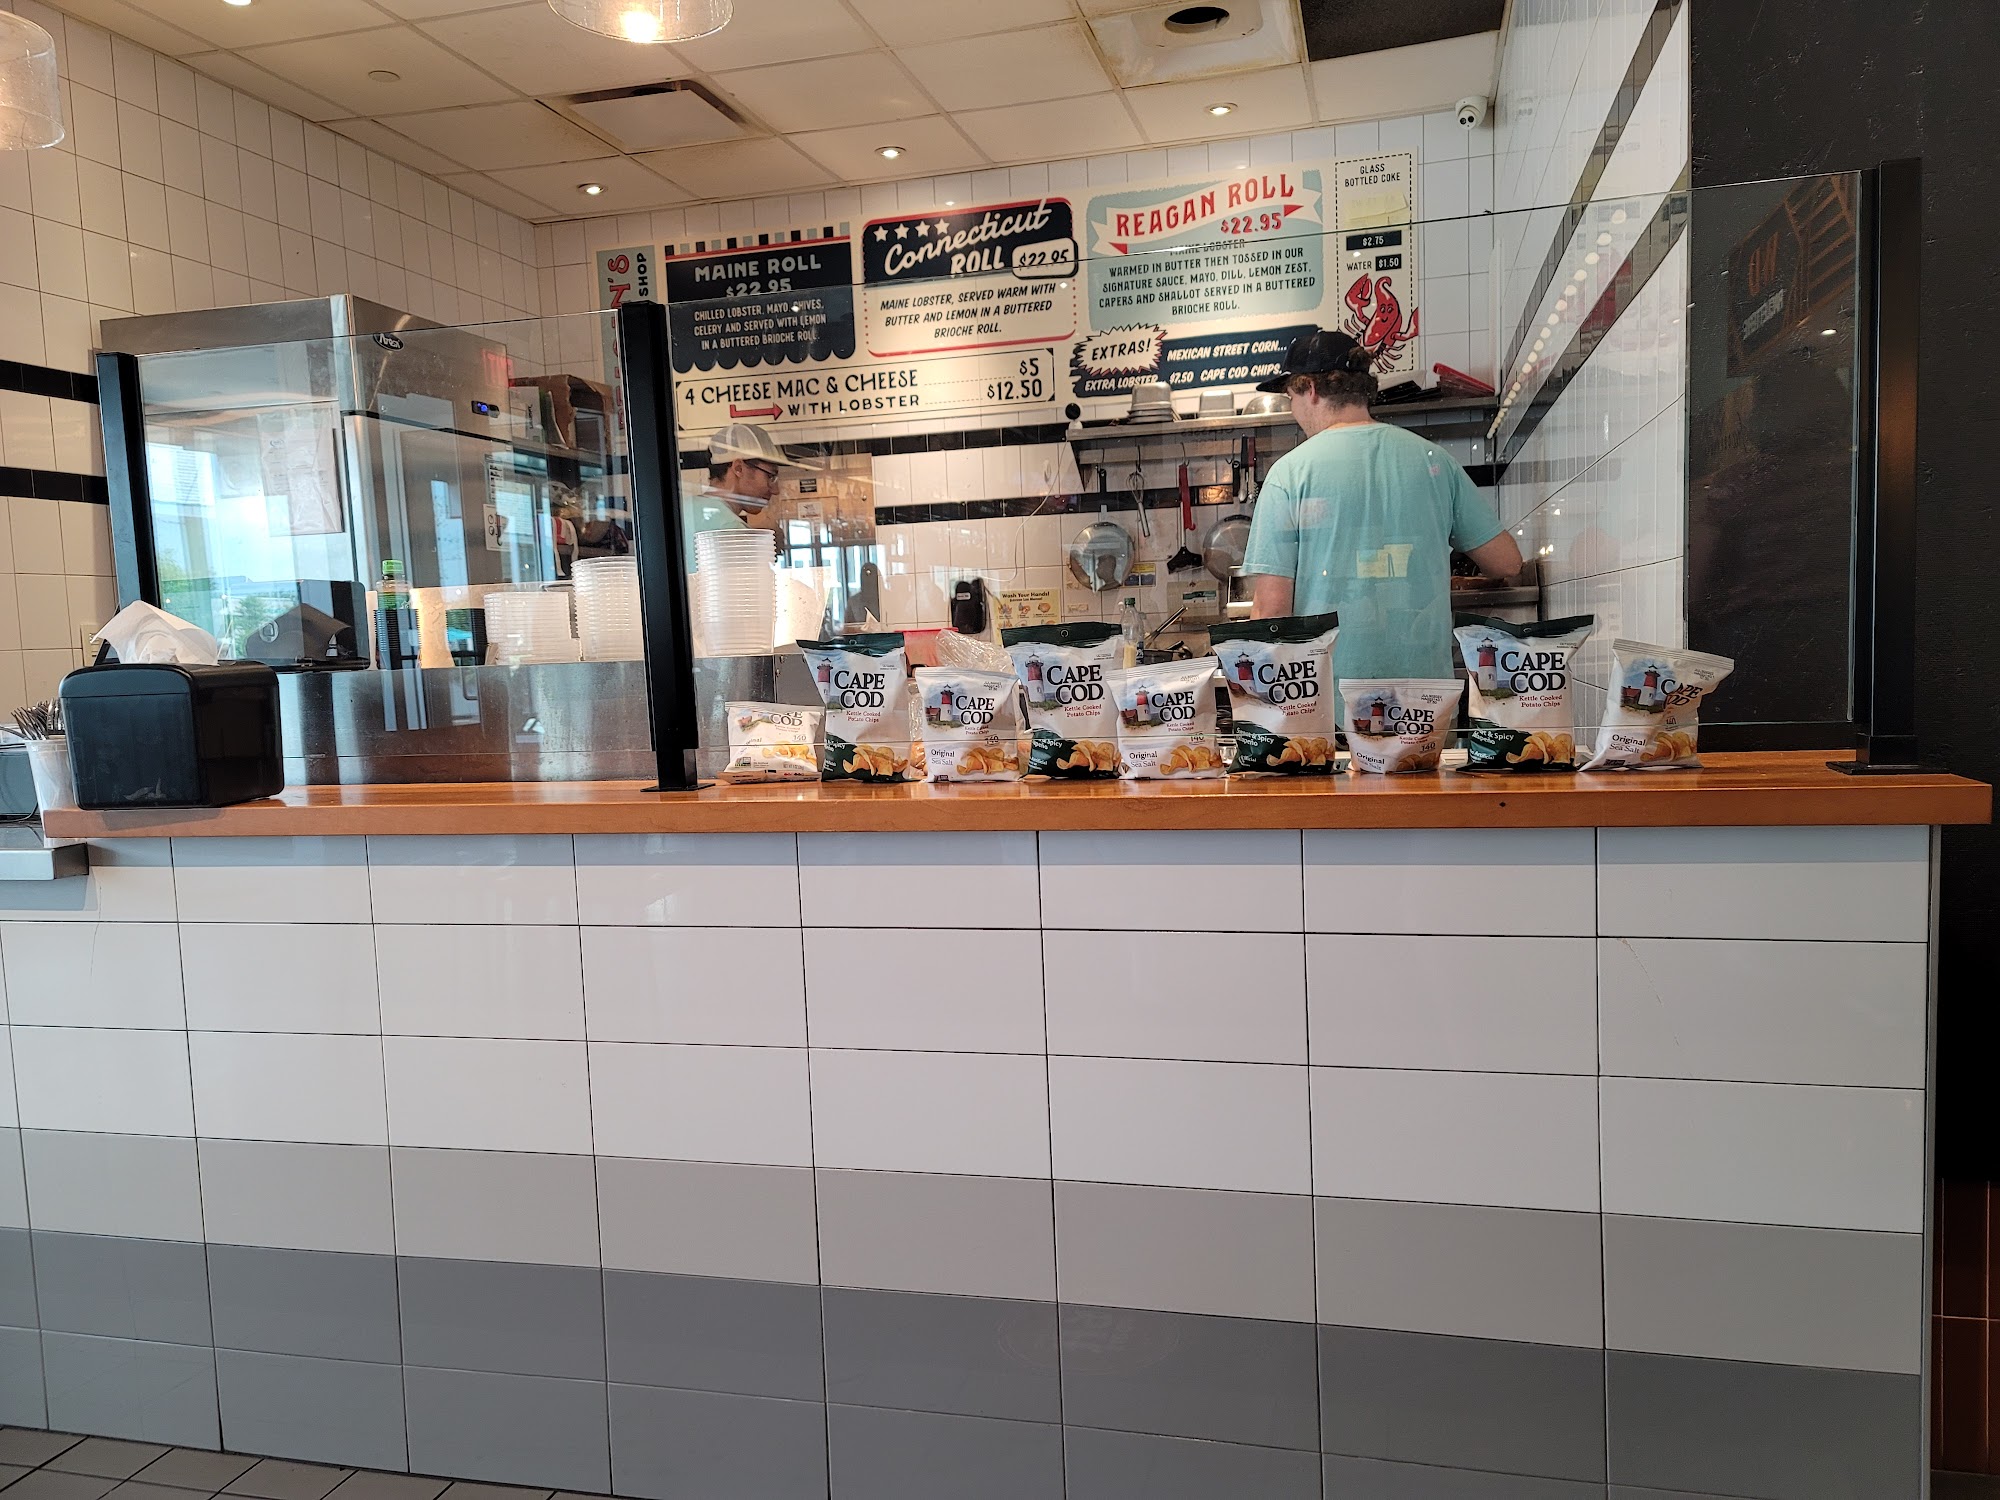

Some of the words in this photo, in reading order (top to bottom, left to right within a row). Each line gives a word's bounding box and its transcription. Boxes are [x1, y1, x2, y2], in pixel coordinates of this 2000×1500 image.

[1360, 163, 1385, 175] GLASS
[1345, 173, 1378, 187] BOTTLED
[1381, 172, 1401, 183] COKE
[1116, 191, 1215, 237] REAGAN
[1228, 174, 1294, 208] ROLL
[1220, 212, 1282, 235] $22.95
[884, 199, 1053, 276] Connecticut
[1362, 235, 1384, 247] $2.75
[695, 261, 759, 282] MAINE
[767, 254, 822, 275] ROLL
[951, 246, 1005, 275] ROLL
[1019, 249, 1069, 268] $2295
[1109, 264, 1149, 278] WARMED
[1152, 262, 1162, 273] IN
[1165, 259, 1201, 272] BUTTER
[1204, 256, 1229, 268] THEN
[1232, 253, 1268, 265] TOSSED
[1272, 250, 1281, 261] IN
[1285, 247, 1304, 258] OUR
[1346, 260, 1372, 271] WATER
[1378, 256, 1399, 268] $1.50
[637, 252, 649, 297] SHOP
[1103, 278, 1152, 293] SIGNATURE
[1249, 266, 1281, 278] LEMON
[726, 278, 792, 298] $2295
[880, 298, 909, 311] MAINE
[912, 293, 954, 307] LOBSTER,
[958, 289, 994, 303] SERVED
[997, 286, 1028, 299] WARM
[1031, 283, 1056, 295] WITH
[1099, 295, 1133, 308] CAPERS
[1136, 293, 1155, 304] AND
[1158, 289, 1200, 302] SHALLOT
[1204, 285, 1240, 298] SERVED
[1243, 283, 1253, 294] IN
[1256, 282, 1262, 292] A
[1265, 276, 1315, 291] BUTTERED
[694, 310, 725, 321] CHILLED
[885, 313, 920, 327] BUTTER
[923, 311, 943, 323] AND
[946, 308, 977, 320] LEMON
[980, 306, 990, 317] IN
[993, 305, 1000, 316] A
[1004, 300, 1052, 315] BUTTERED
[1172, 302, 1210, 316] BRIOCHE
[1214, 299, 1240, 311] ROLL.
[694, 324, 723, 336] CELERY
[725, 322, 741, 333] AND
[744, 319, 774, 331] SERVED
[777, 316, 798, 328] WITH
[800, 314, 827, 326] LEMON
[934, 325, 974, 338] BRIOCHE
[977, 323, 1002, 335] ROLL.
[701, 340, 710, 350] IN
[712, 339, 718, 349] A
[720, 336, 760, 349] BUTTERED
[762, 332, 795, 345] BRIOCHE
[798, 330, 820, 342] ROLL.
[1092, 338, 1151, 361] EXTRAS!
[1167, 346, 1211, 362] MEXICAN
[1213, 343, 1250, 357] STREET
[1251, 340, 1287, 354] CORN...
[685, 387, 695, 406] 4
[701, 381, 771, 404] CHEESE
[778, 378, 821, 399] MAC
[826, 377, 838, 394] &
[845, 369, 918, 392] CHEESE
[1019, 358, 1039, 377] $5
[1085, 377, 1116, 391] EXTRA
[1169, 371, 1194, 384] $7.50
[1200, 368, 1226, 381] CAPE
[1228, 366, 1249, 379] COD
[788, 401, 831, 417] WITH
[839, 394, 920, 413] LOBSTER
[987, 378, 1043, 402] $12.50
[1500, 651, 1566, 672] CAPE
[834, 670, 885, 689] CAPE
[1046, 665, 1102, 685] CAPE
[1257, 660, 1317, 684] CAPE
[1660, 679, 1703, 699] CAPE
[955, 695, 994, 710] CAPE
[1151, 691, 1194, 708] CAPE
[1388, 706, 1435, 723] CAPE
[1257, 735, 1275, 744] Spicy
[1494, 733, 1514, 741] Spicy
[1609, 743, 1623, 751] Sea
[1612, 734, 1646, 746] Original
[931, 749, 955, 757] Original
[1129, 751, 1158, 760] Original
[1356, 752, 1385, 764] Original
